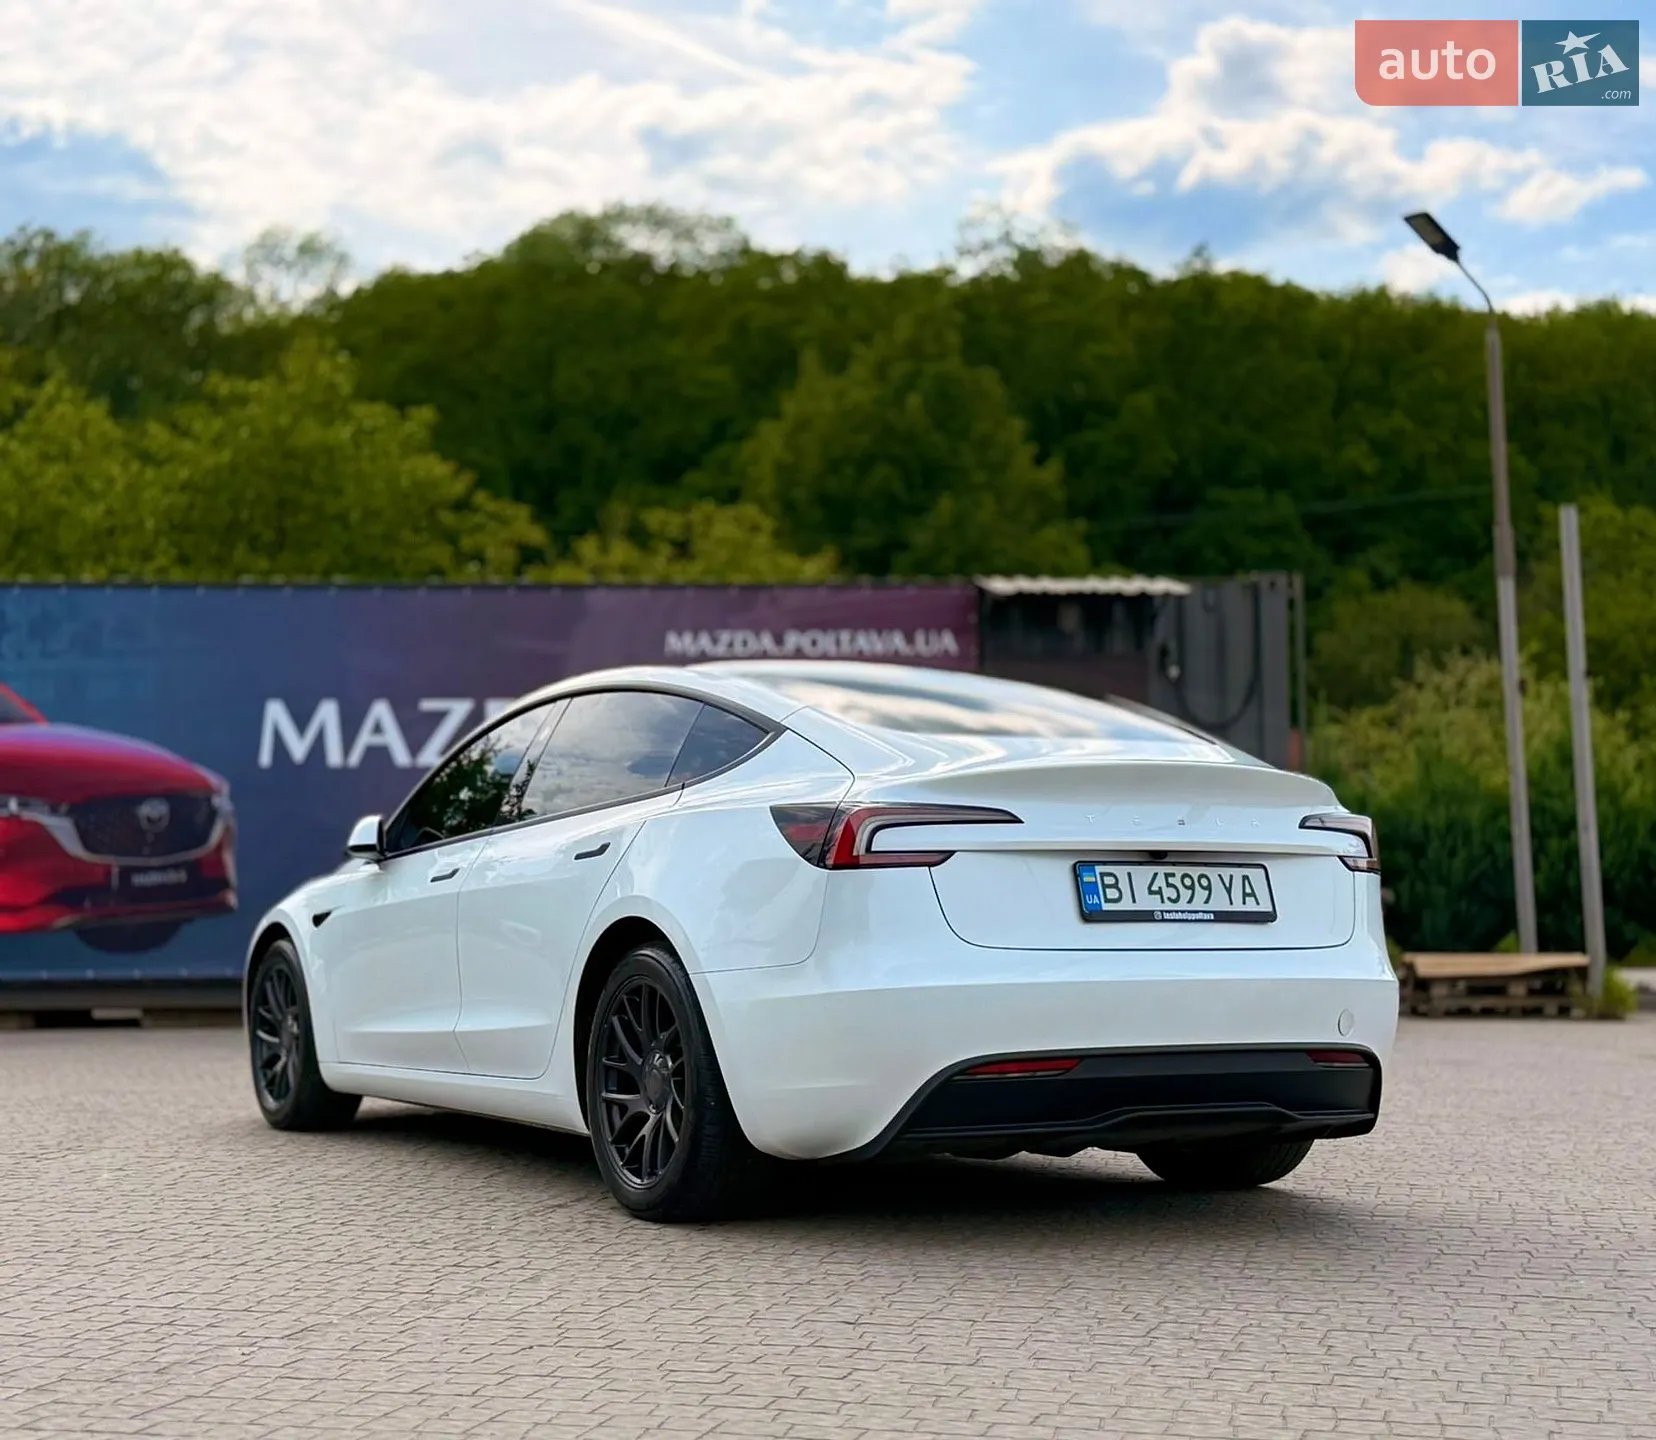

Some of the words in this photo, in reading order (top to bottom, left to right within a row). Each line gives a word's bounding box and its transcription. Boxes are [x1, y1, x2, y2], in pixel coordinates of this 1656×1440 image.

[664, 628, 960, 657] MAZDA.POLTAVA.UA
[257, 697, 522, 769] MAZ
[1086, 894, 1100, 904] UA
[1099, 871, 1137, 904] BI
[1147, 871, 1212, 904] 4599
[1218, 873, 1260, 906] YA
